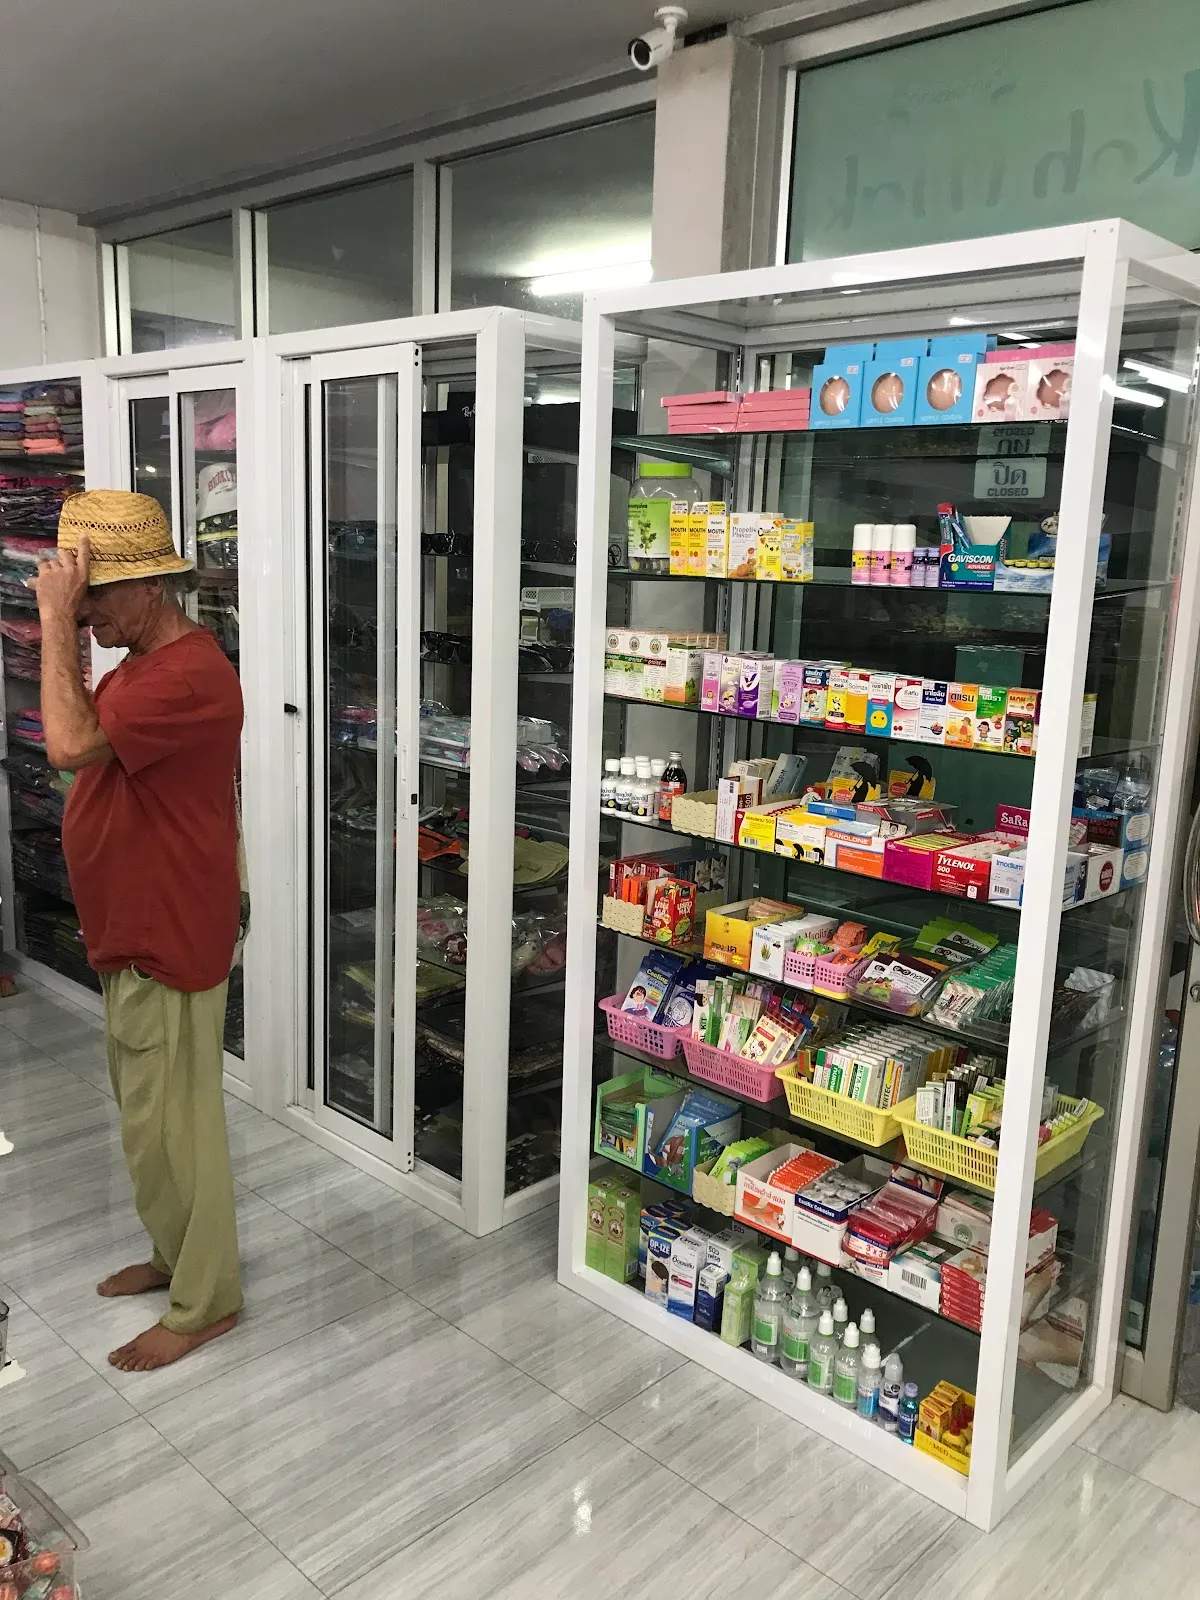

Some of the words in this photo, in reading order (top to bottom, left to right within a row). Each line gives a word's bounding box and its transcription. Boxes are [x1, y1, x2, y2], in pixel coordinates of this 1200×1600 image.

[992, 461, 1027, 486] ปิด
[987, 487, 1029, 497] CLOSED
[947, 553, 994, 564] GAVISCON
[1000, 812, 1029, 827] SaRa
[937, 853, 976, 871] TYLENOL
[936, 865, 950, 873] 500
